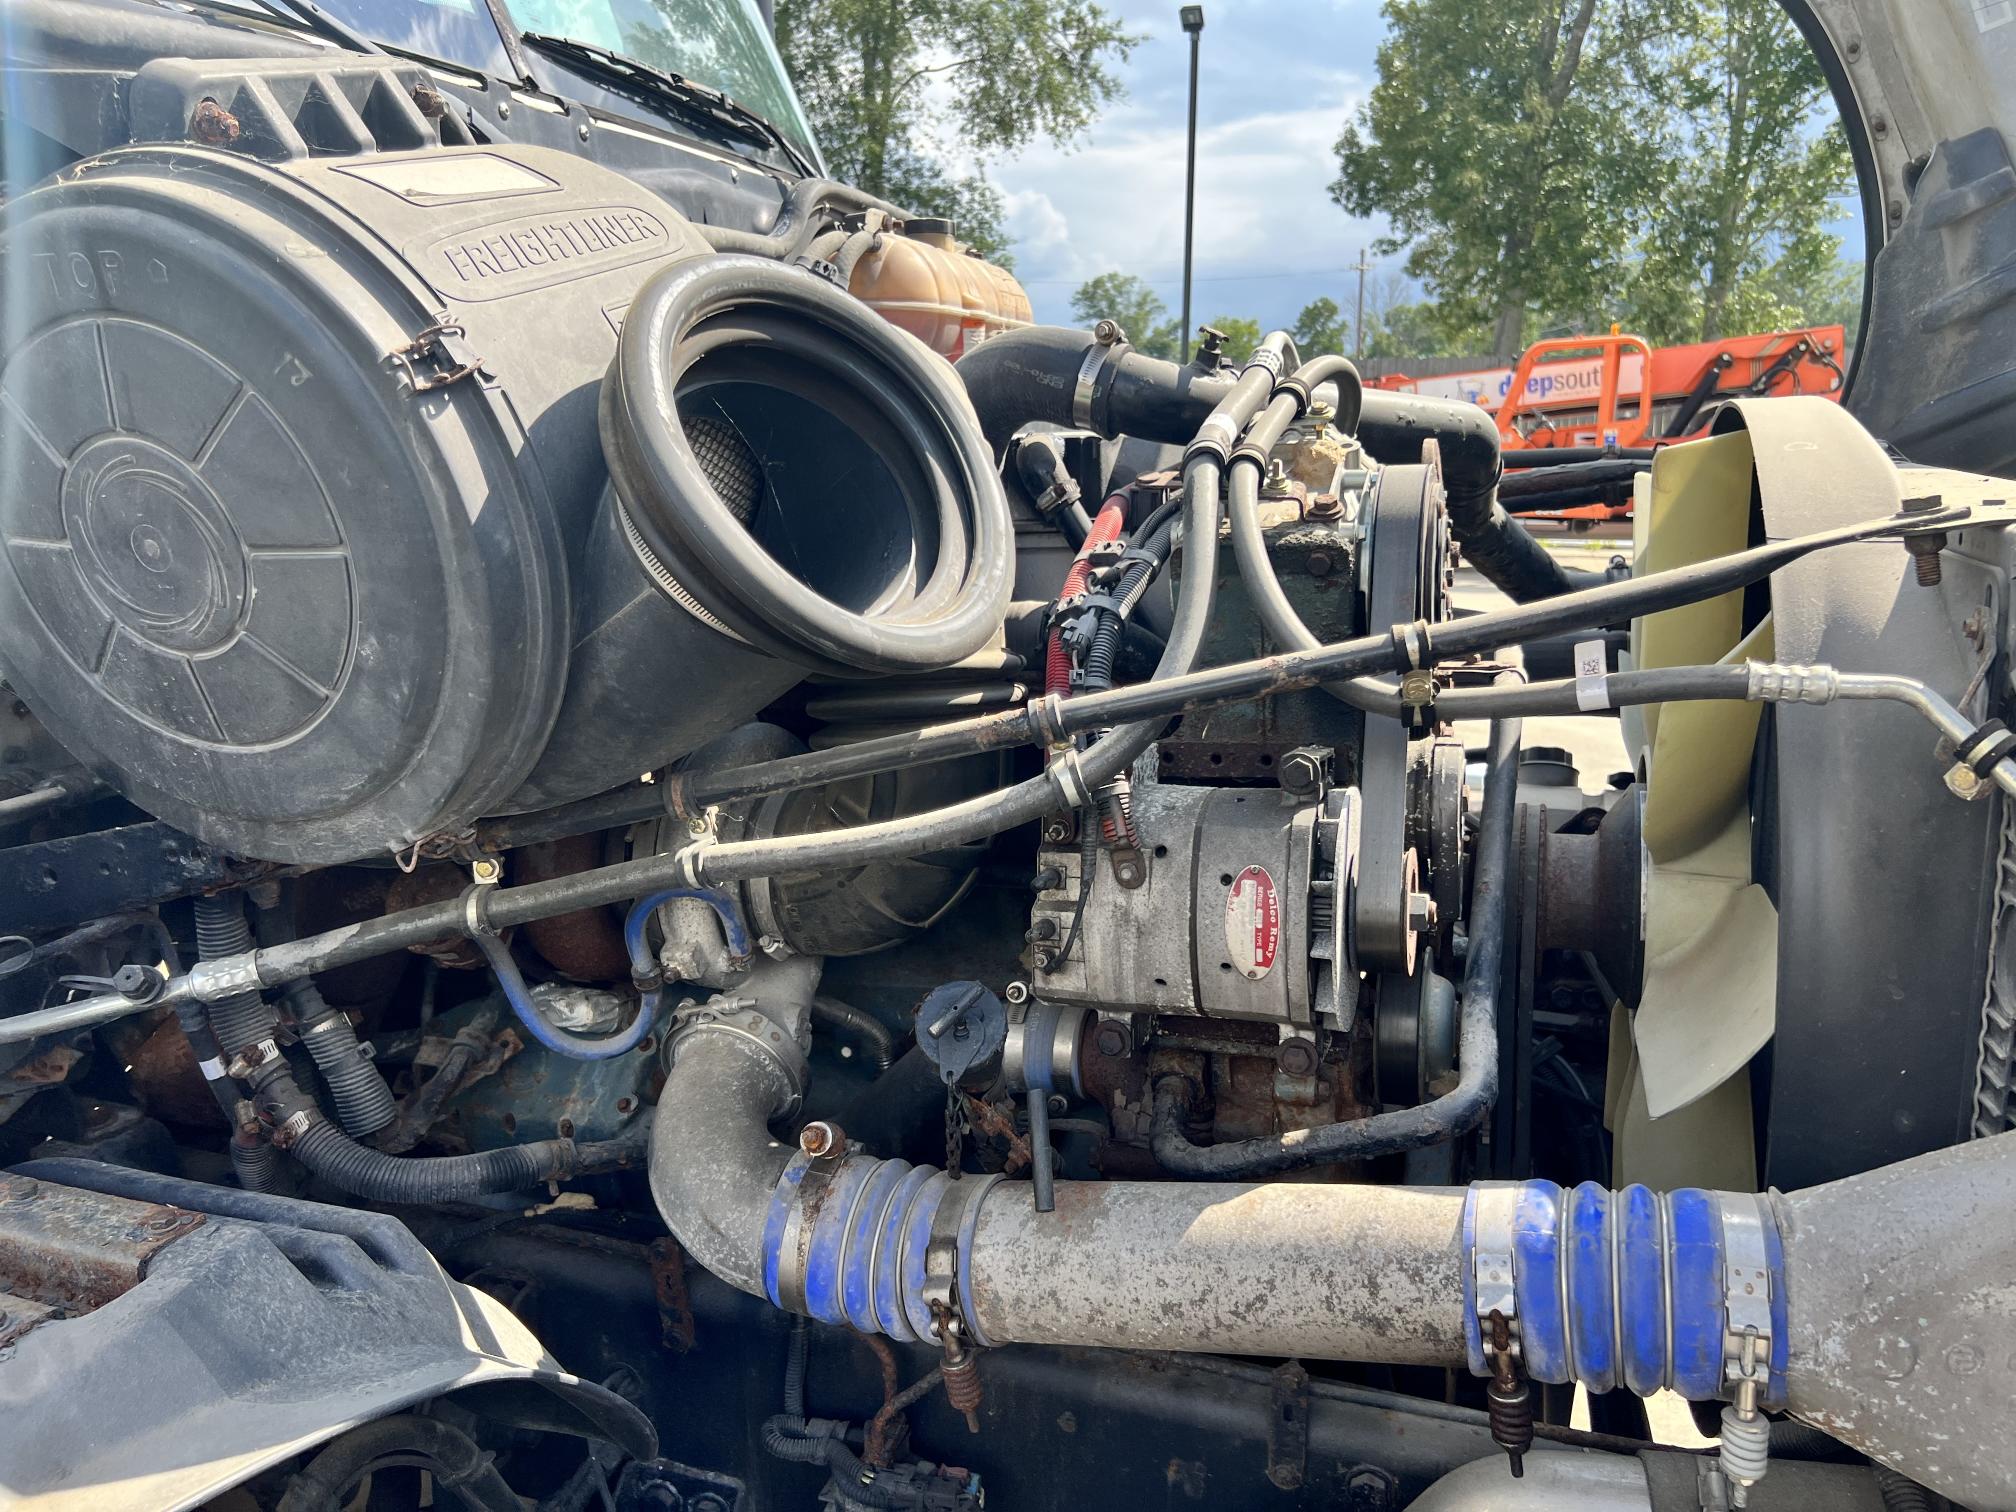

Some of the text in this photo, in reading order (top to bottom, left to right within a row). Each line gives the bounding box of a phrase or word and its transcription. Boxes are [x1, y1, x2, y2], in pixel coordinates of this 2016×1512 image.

[32, 250, 124, 299] TOP
[444, 213, 659, 281] FREIGHTLINER
[1266, 888, 1278, 958] Delco Remy
